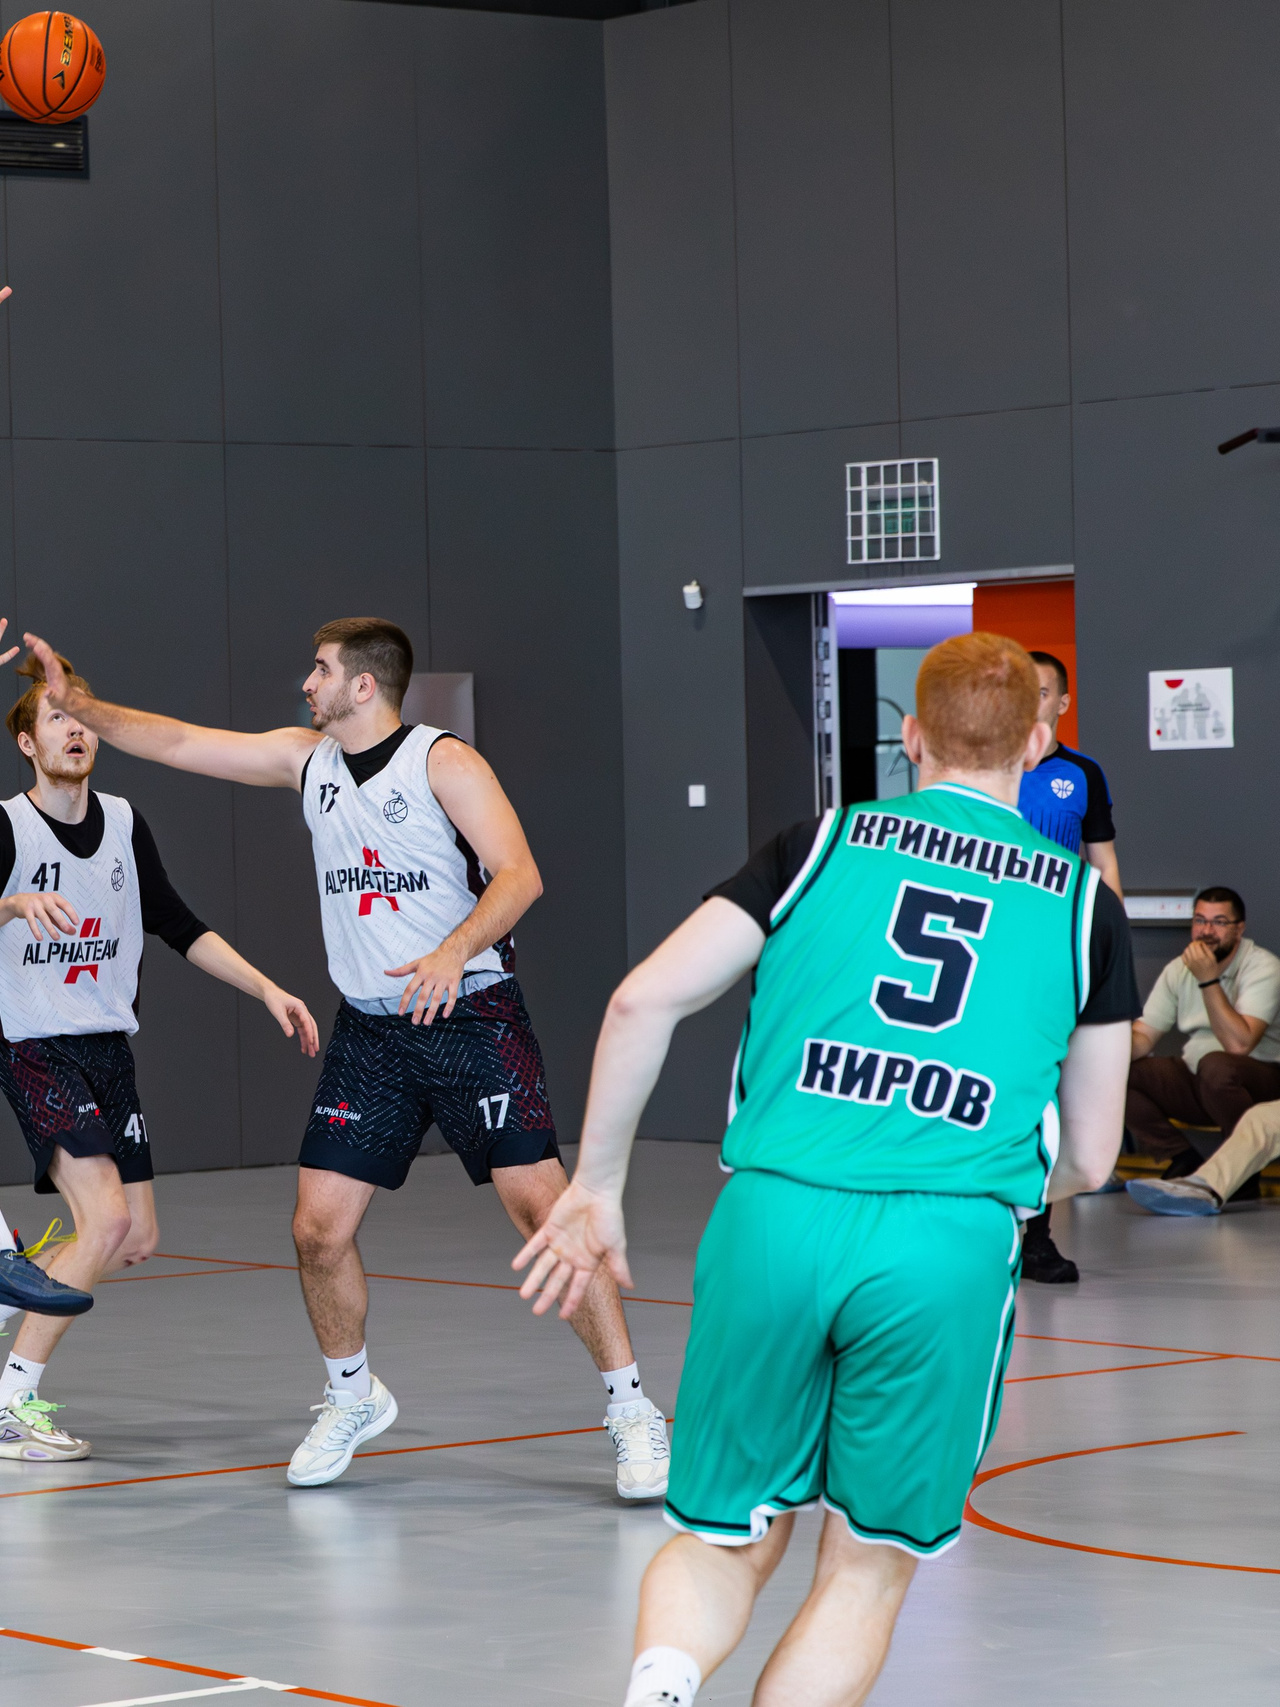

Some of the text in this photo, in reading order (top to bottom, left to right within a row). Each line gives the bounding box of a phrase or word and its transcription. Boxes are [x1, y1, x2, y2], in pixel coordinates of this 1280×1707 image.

[319, 782, 341, 814] 17
[847, 811, 1072, 897] КРИНИЦЫН
[31, 862, 61, 892] 41
[325, 868, 430, 896] ALPHATEAM
[870, 879, 994, 1033] 5
[796, 1038, 996, 1131] КИРОВ
[315, 1104, 361, 1122] ALPHATEAM
[478, 1092, 509, 1129] 17
[124, 1113, 148, 1144] 41
